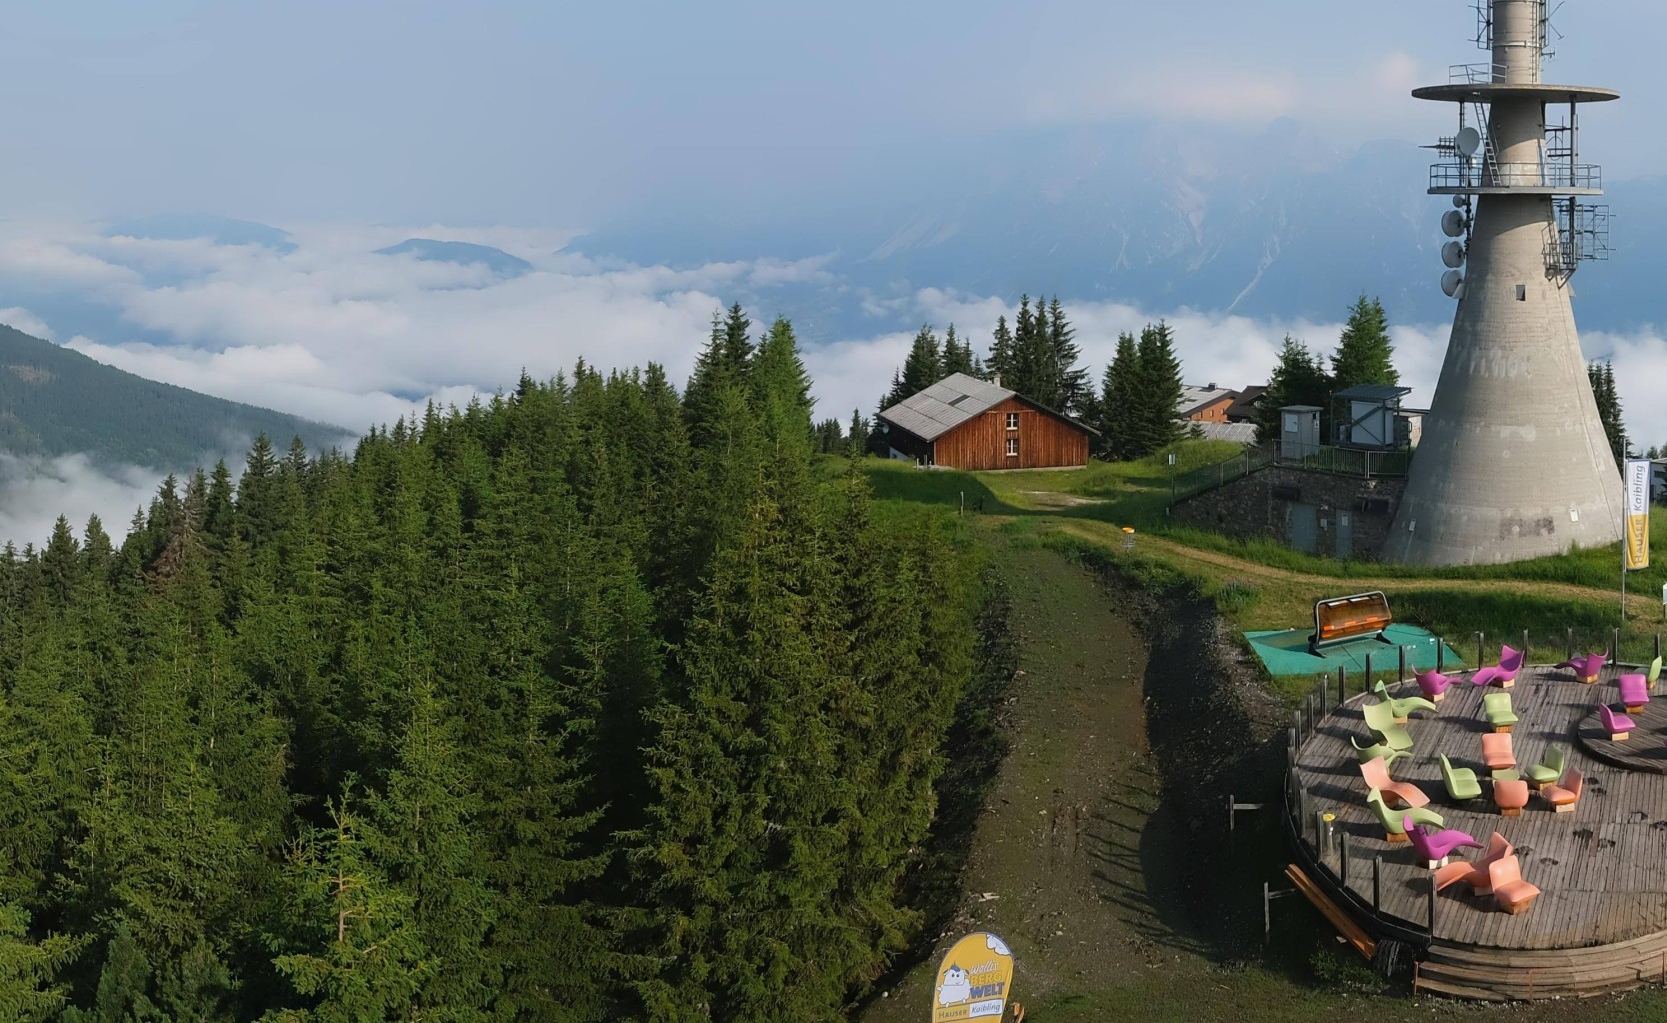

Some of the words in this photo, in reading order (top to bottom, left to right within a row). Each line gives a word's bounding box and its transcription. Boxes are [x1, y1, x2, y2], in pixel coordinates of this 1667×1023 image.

[1633, 465, 1646, 511] Kaibling
[1635, 519, 1643, 564] HAUSER
[970, 972, 1002, 985] BERG
[969, 982, 1005, 999] WELT
[938, 1009, 967, 1019] HAUSER
[971, 1003, 1001, 1014] Kaibling
